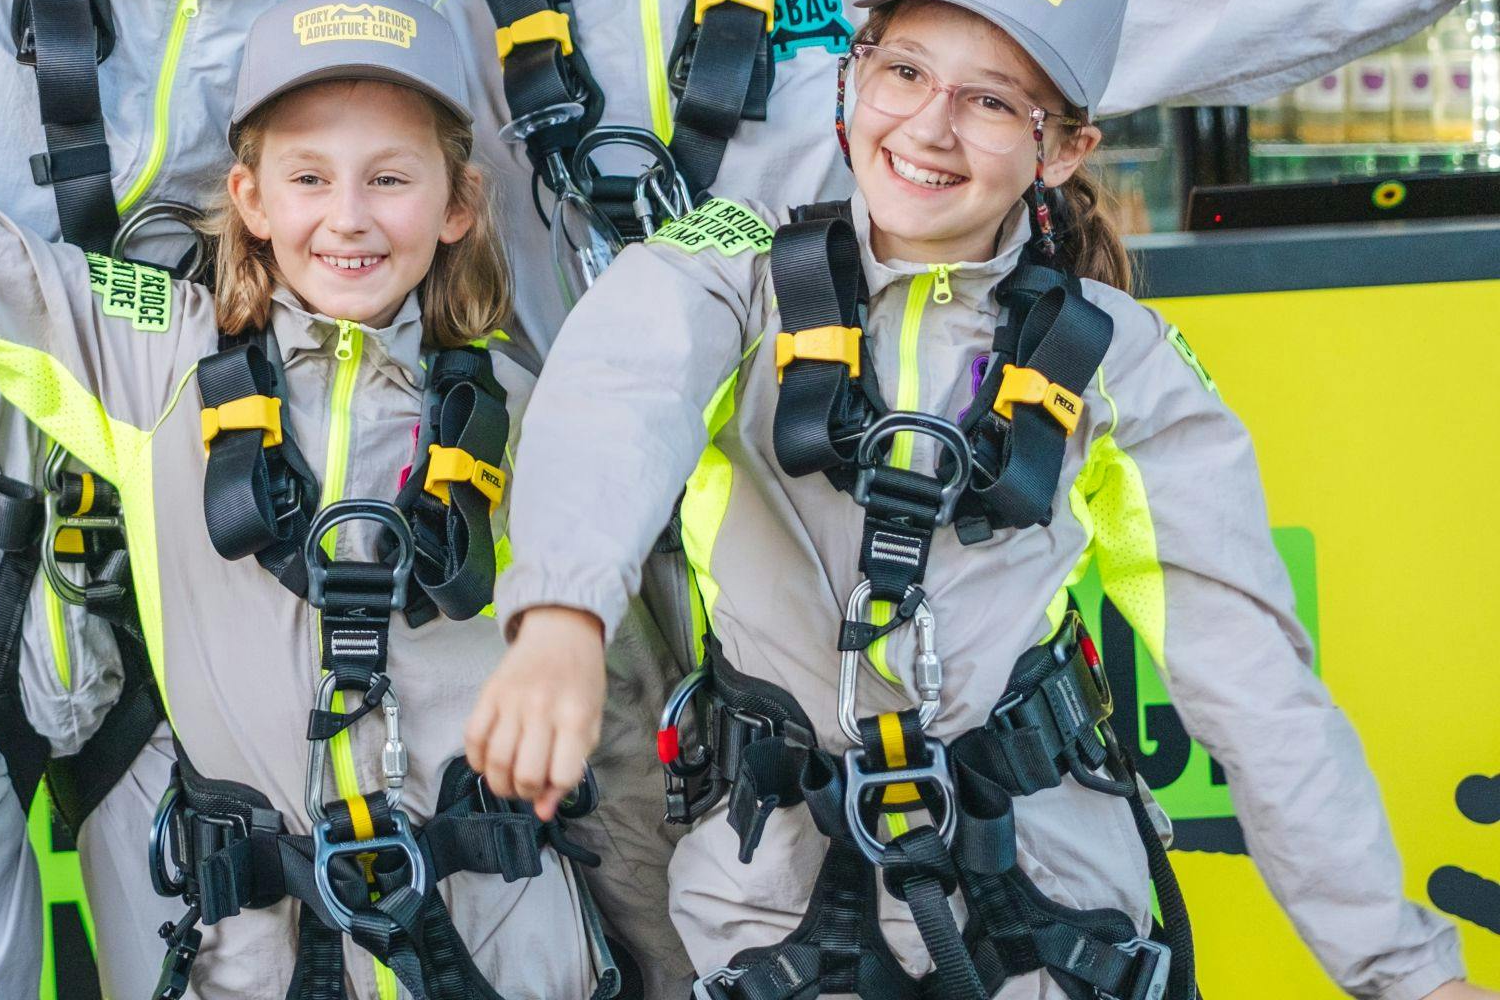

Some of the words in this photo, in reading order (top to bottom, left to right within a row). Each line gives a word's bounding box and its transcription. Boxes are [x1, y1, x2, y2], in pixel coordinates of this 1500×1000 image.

[298, 9, 330, 29] STORY
[377, 9, 412, 32] BRIDGE
[306, 22, 369, 40] ADVENTURE
[372, 23, 405, 43] CLIMB
[715, 204, 774, 248] BRIDGE
[138, 273, 166, 326] BRIDGE
[1053, 392, 1077, 415] PETZL
[481, 468, 502, 489] PETZL
